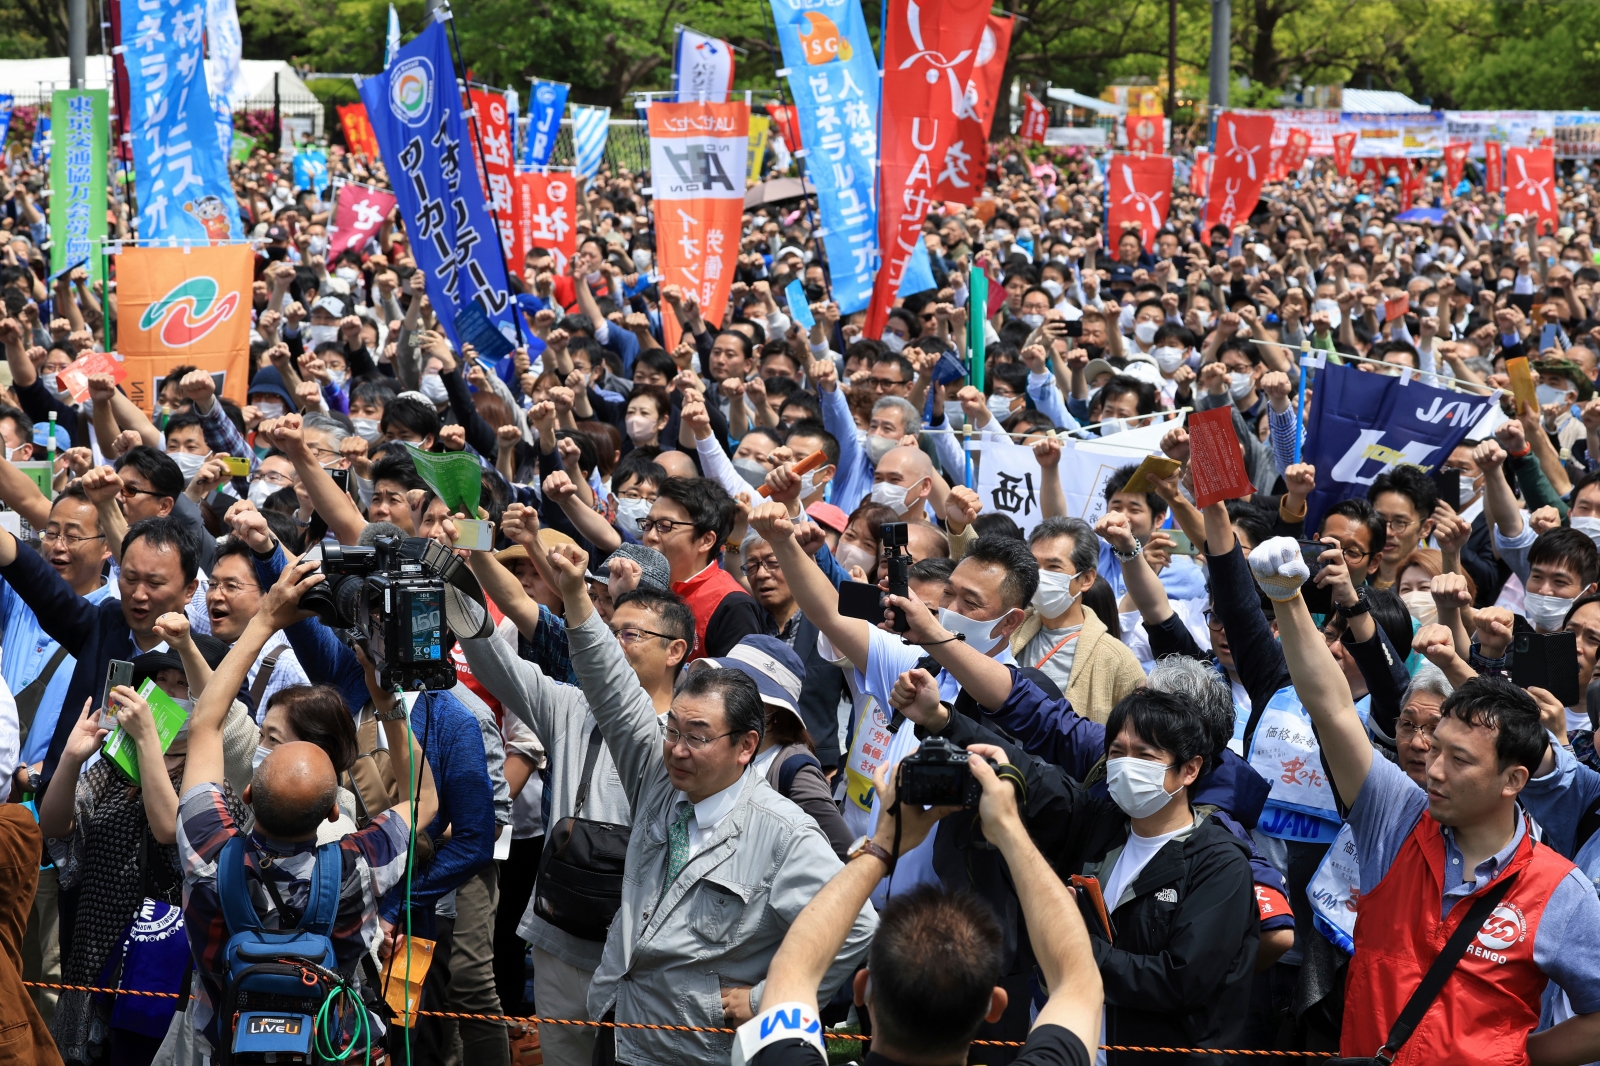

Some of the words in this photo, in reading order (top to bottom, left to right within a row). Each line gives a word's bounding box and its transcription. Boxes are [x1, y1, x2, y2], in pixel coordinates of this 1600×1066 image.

[162, 0, 206, 197] 材サービス
[65, 96, 94, 287] 東京交通協力会労働組
[1415, 396, 1486, 427] JAM
[861, 742, 884, 761] 価値
[1262, 808, 1321, 838] JAM
[1312, 887, 1338, 910] JAM
[1466, 944, 1507, 964] RENGO
